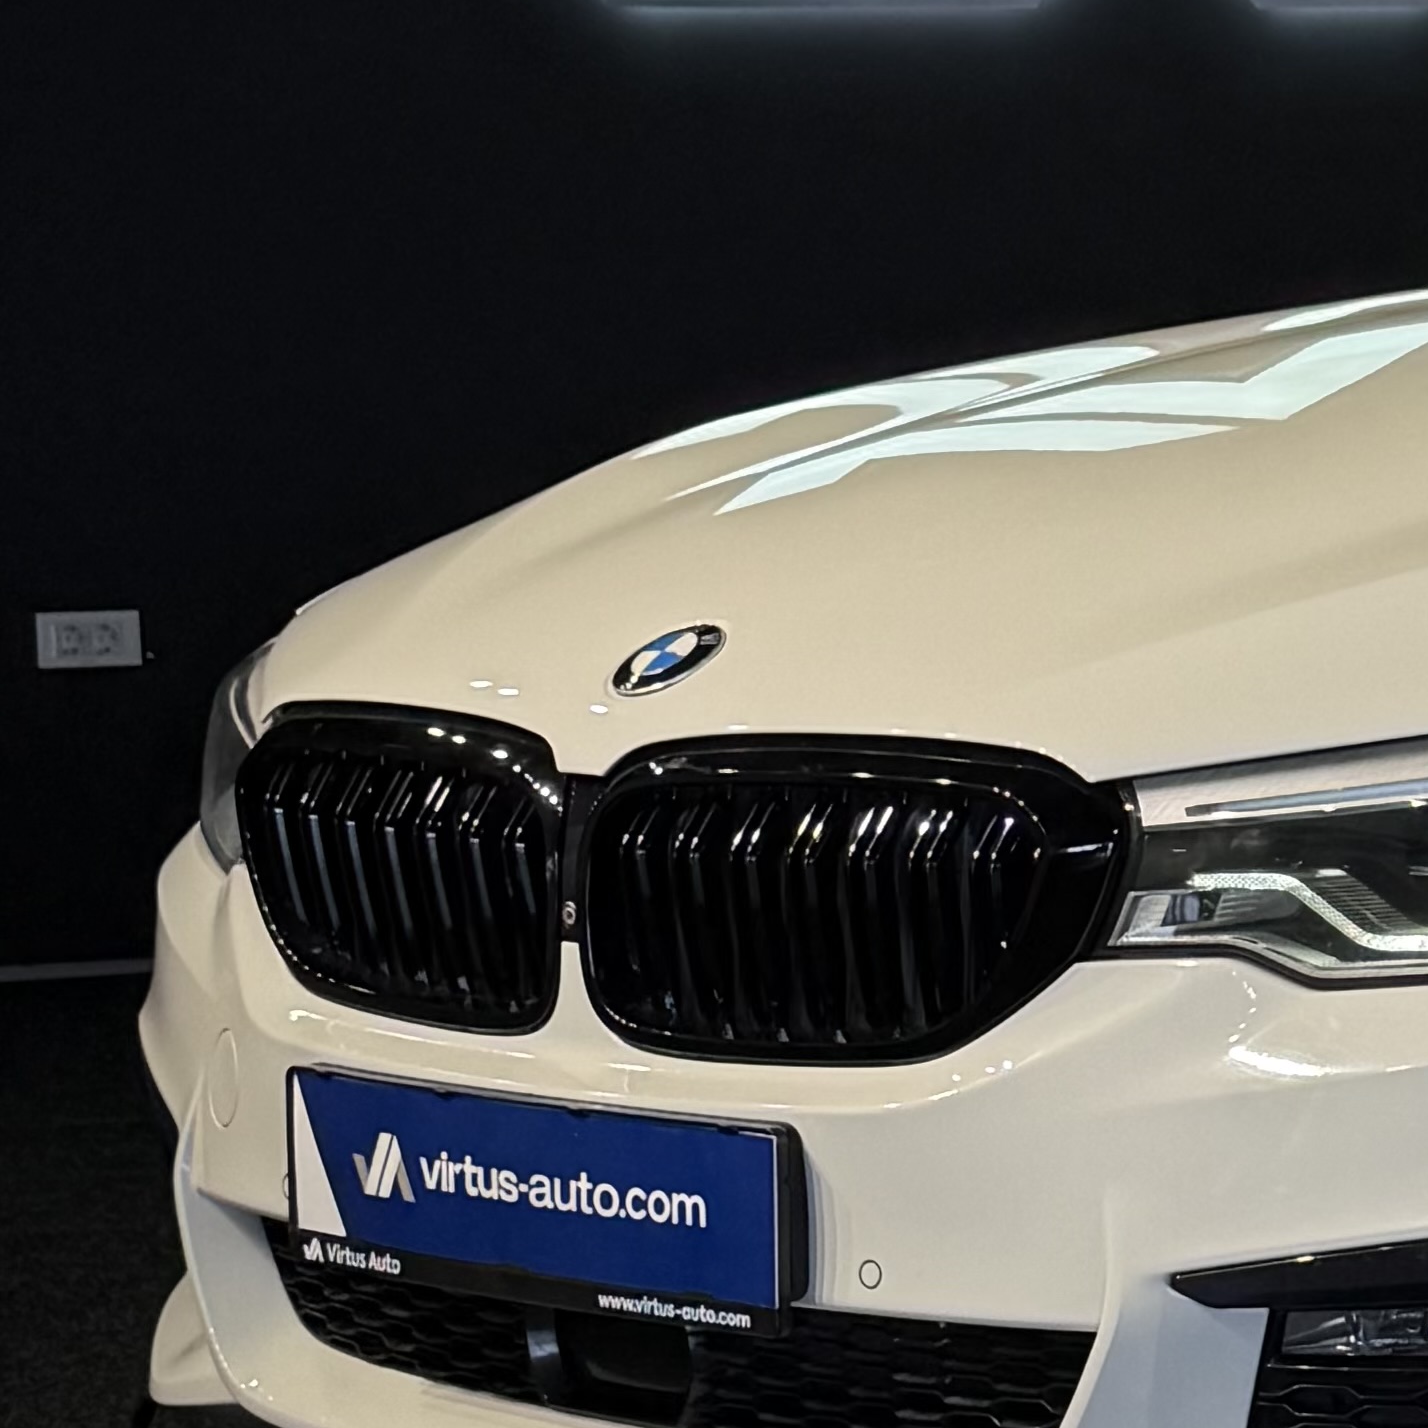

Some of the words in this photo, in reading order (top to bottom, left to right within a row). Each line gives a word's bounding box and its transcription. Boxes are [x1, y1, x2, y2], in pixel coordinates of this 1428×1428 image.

[419, 1151, 707, 1228] virtus-auto.com
[326, 1242, 366, 1269] Virtus
[368, 1251, 401, 1275] Auto
[598, 1294, 752, 1328] www.virtus-auto.com
